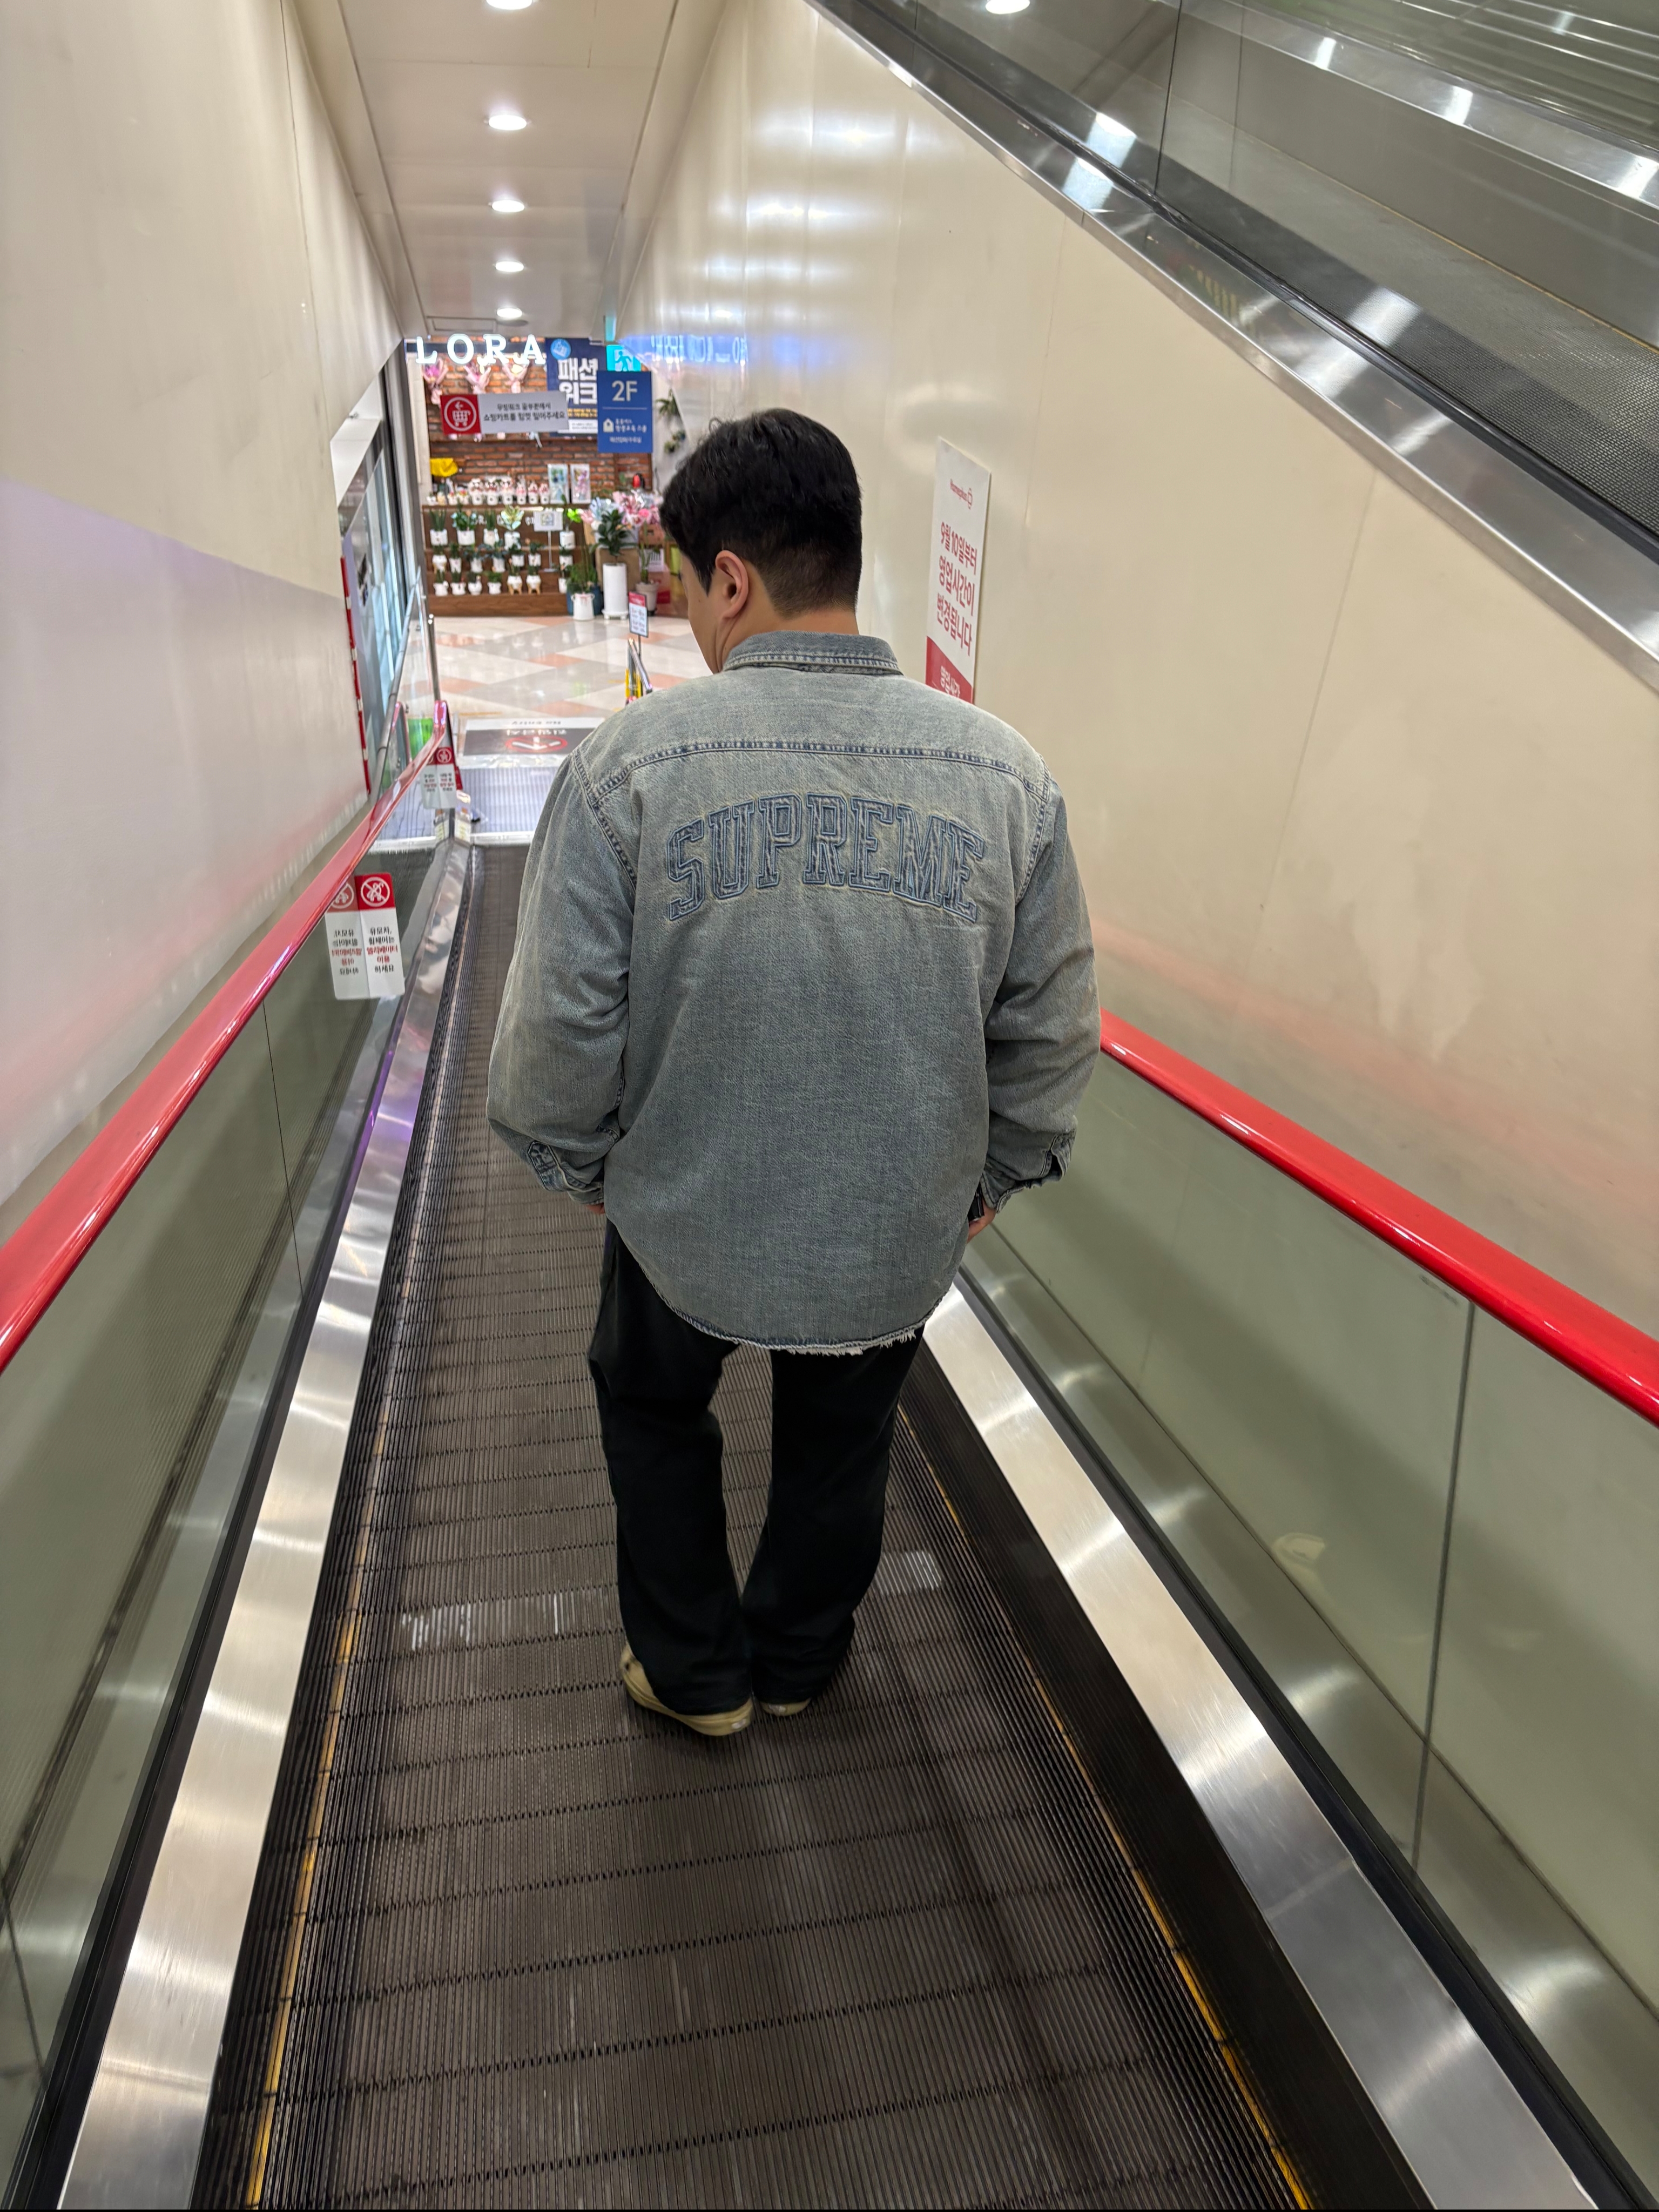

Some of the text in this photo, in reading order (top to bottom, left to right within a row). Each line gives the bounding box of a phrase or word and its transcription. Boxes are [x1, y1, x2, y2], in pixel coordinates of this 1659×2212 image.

[557, 357, 598, 381] 패션
[558, 381, 598, 405] 워크
[612, 380, 638, 402] 2F
[941, 521, 977, 576] 9월 10일부터
[939, 555, 975, 617] 영업시간이
[937, 592, 972, 657] 변경됩니다
[665, 792, 984, 923] SUPREME
